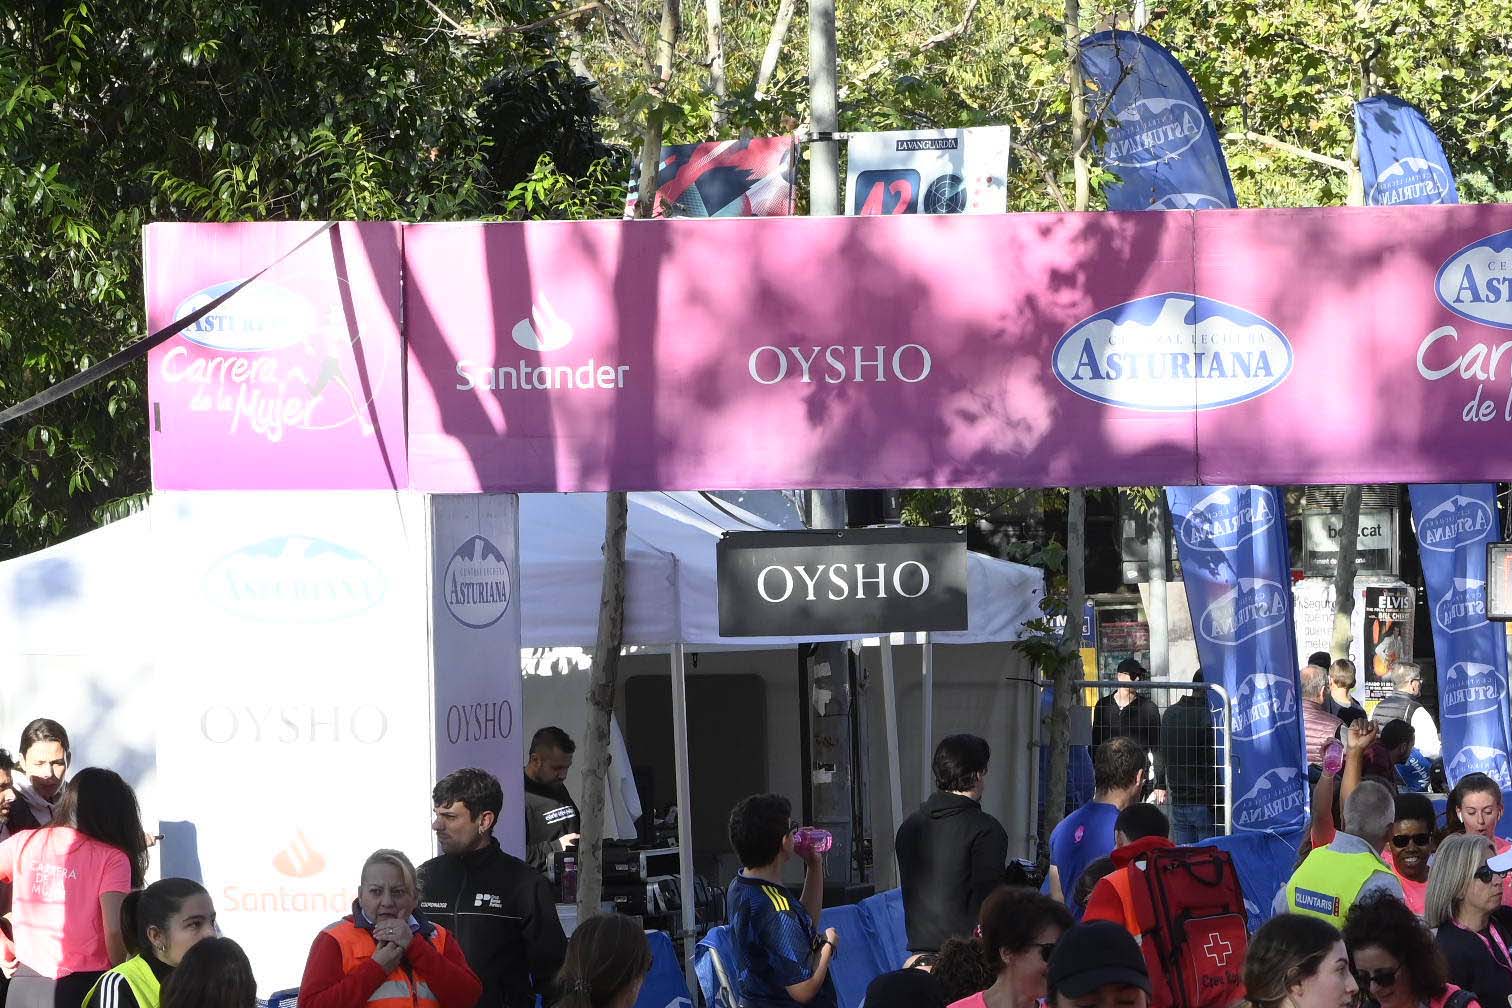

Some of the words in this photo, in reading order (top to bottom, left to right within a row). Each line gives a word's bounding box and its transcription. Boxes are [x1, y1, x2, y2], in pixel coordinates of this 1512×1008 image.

[1072, 328, 1274, 384] ASTURIANA
[1108, 331, 1184, 347] CENTRAL
[1193, 331, 1268, 346] LECHERA
[456, 359, 630, 391] Santander
[747, 343, 933, 386] OYSHO
[1463, 384, 1498, 424] de
[449, 570, 508, 606] ASTURIANA
[755, 559, 931, 602] OYSHO
[1378, 595, 1410, 609] ELVIS
[446, 699, 513, 745] OYSHO
